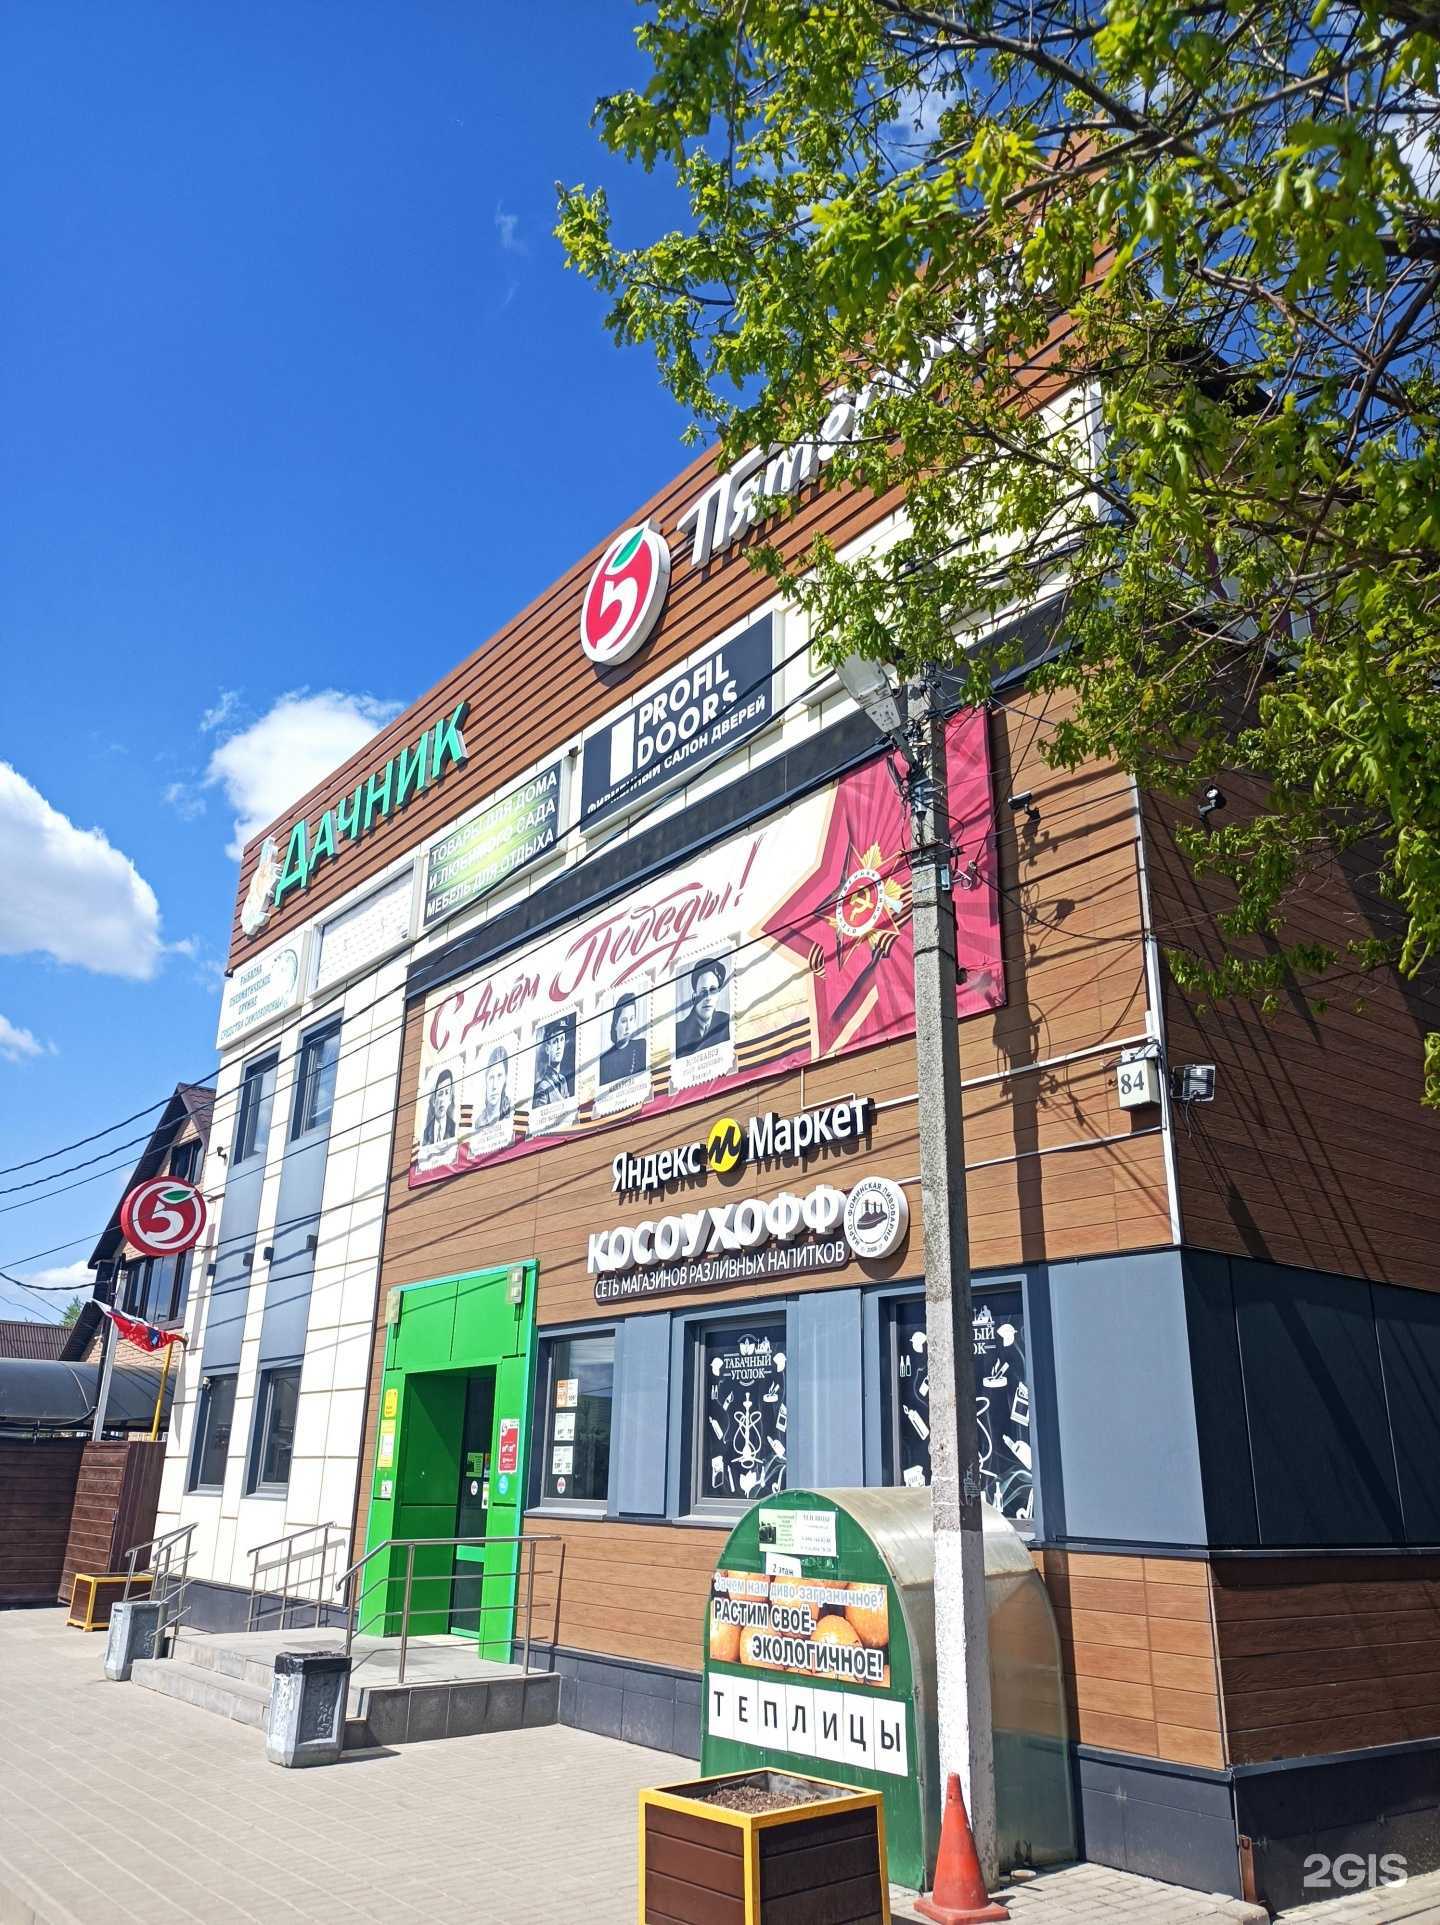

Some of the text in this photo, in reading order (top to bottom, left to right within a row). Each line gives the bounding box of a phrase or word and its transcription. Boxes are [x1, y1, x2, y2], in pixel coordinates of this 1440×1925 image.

[636, 680, 738, 769] DOORS
[638, 653, 730, 736] PROFIL
[664, 734, 709, 769] САЛОН
[711, 694, 766, 745] ДВЕРЕЙ
[273, 701, 469, 907] ДАЧНИК
[431, 820, 482, 865] ТОВАРЫ
[514, 771, 557, 806] ДОМА
[426, 828, 554, 918] МЕБЕЛЬ ДЛЯ ОТДЫХА
[429, 875, 437, 891] И
[517, 798, 556, 833] САДА
[429, 990, 465, 1051] С
[1120, 1070, 1145, 1095] 84
[611, 1142, 702, 1193] Яндекс
[745, 1097, 869, 1163] Маркет
[587, 1184, 845, 1273] КОСОУХОФФ
[595, 1240, 846, 1299] СЕТЬ МАГАЗИНОВ РАЗЛИВНЫХ НАПИТКОВ
[723, 1353, 772, 1369] ТАБАЧНЫЙ
[730, 1368, 766, 1380] УГОЛОК
[714, 1573, 884, 1608] Зачем нам диво заграничное?
[714, 1599, 769, 1626] РАСТИМ
[752, 1635, 883, 1678] ЭКОЛОГИЧНОЕ!
[713, 1690, 902, 1753] ТЕПЛИЦЫ
